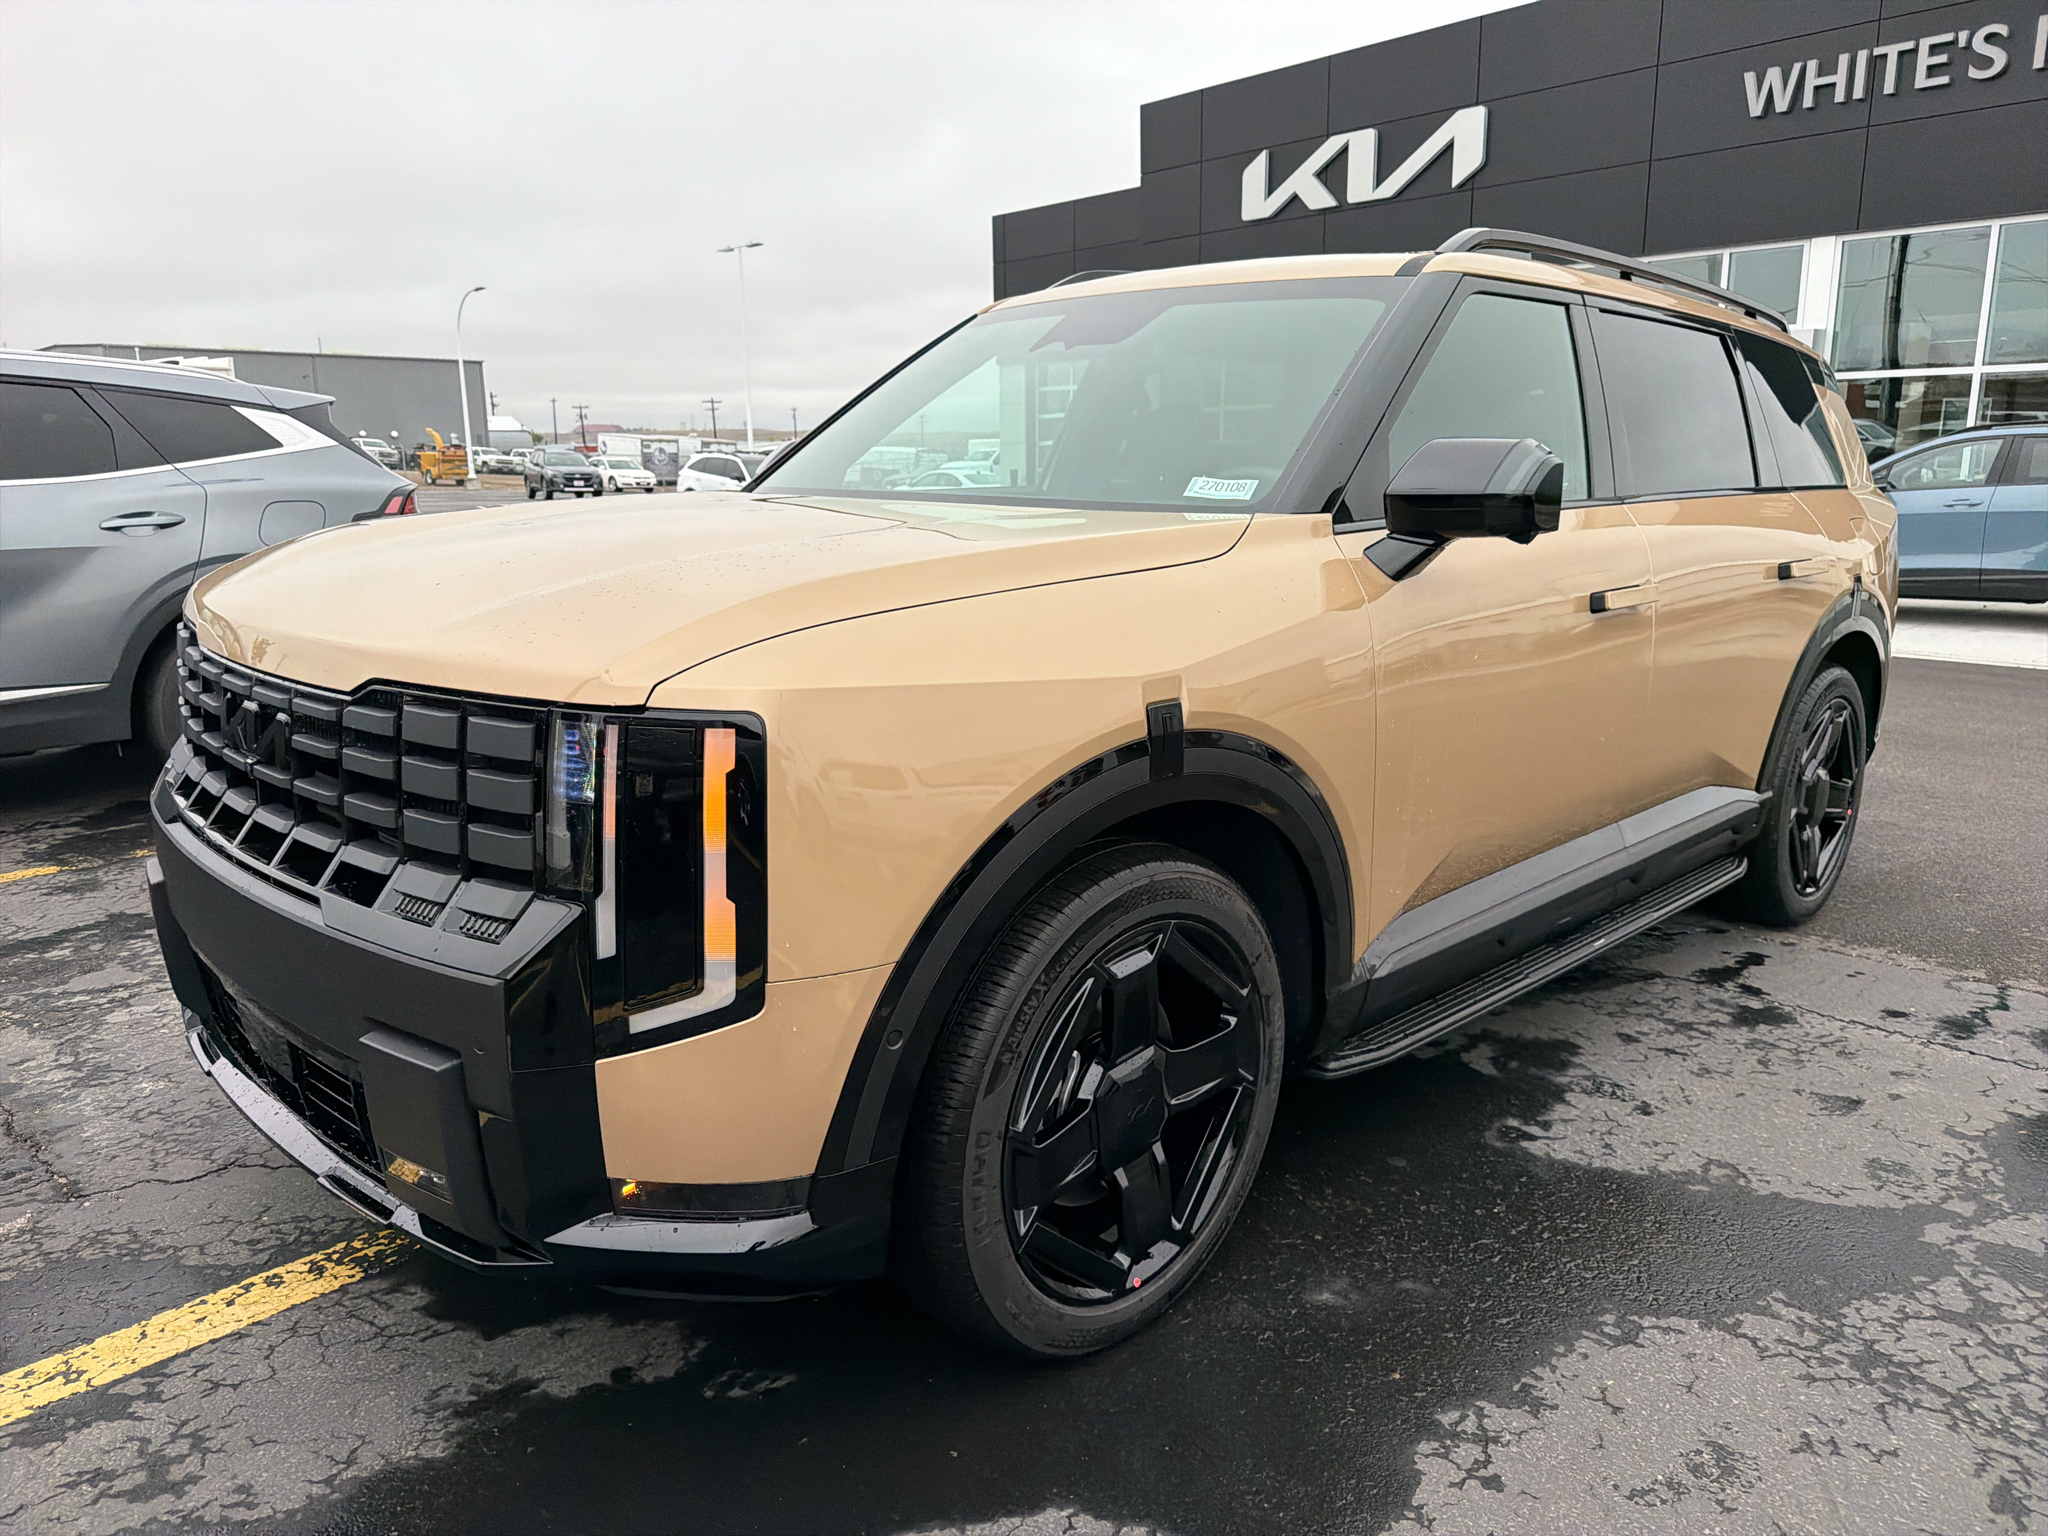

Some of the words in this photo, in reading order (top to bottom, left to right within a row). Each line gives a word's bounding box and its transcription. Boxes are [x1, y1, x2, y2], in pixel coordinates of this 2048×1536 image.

[1743, 23, 2010, 118] WHITE'S
[1241, 105, 1488, 222] KIA
[1198, 480, 1248, 493] 270108
